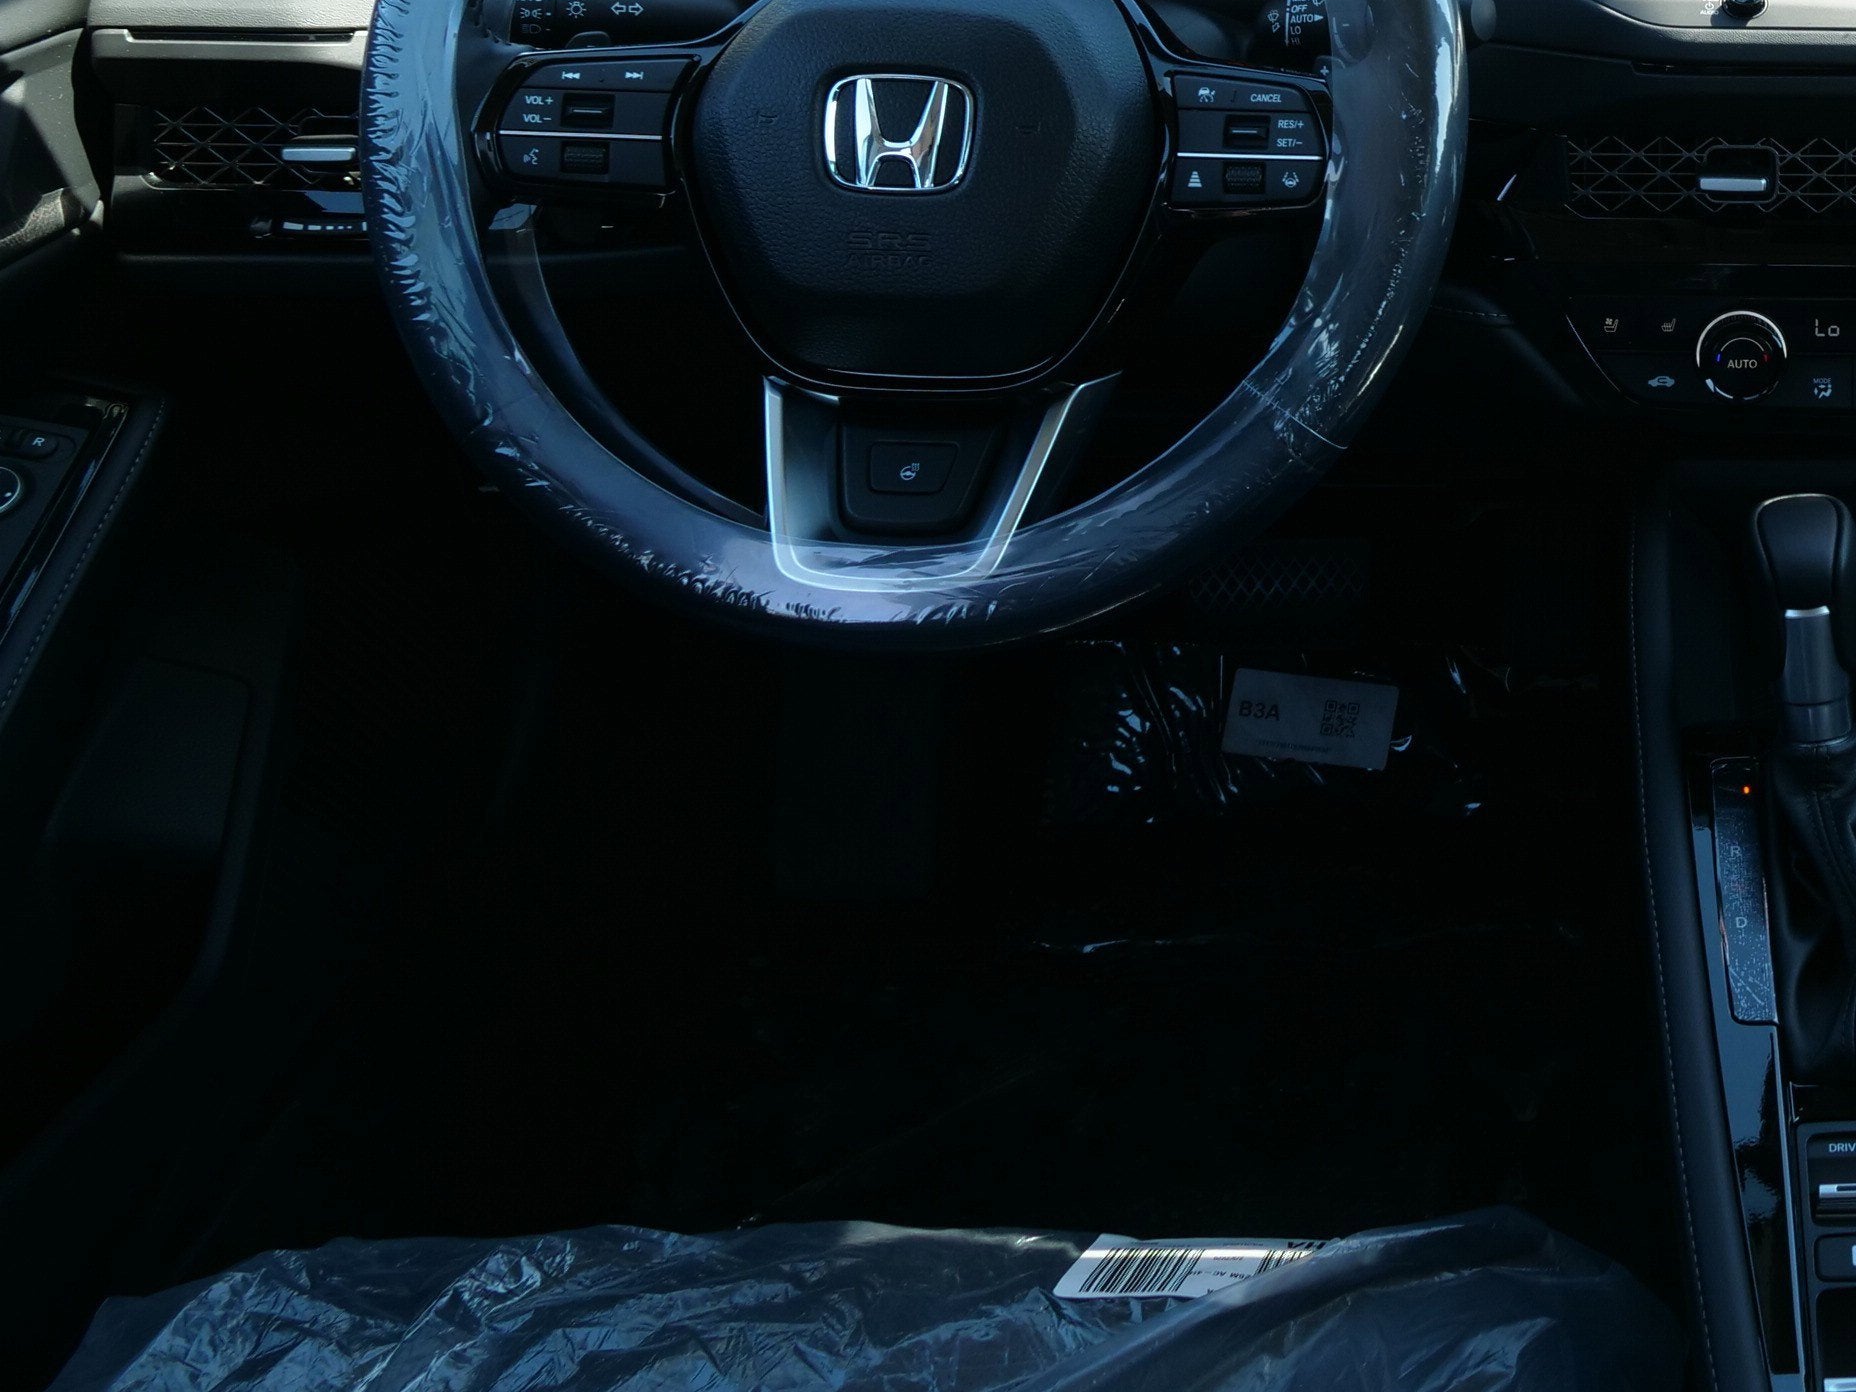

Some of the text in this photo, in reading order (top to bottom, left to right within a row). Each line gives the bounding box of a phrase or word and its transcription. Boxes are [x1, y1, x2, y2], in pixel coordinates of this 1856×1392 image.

[1291, 5, 1308, 13] OFF
[1290, 14, 1313, 23] AUTO
[1291, 26, 1301, 34] LO
[1251, 94, 1282, 103] CANCEL
[1278, 120, 1304, 129] RES/+
[1277, 139, 1302, 147] SET/-
[1728, 360, 1758, 369] AUTO
[32, 437, 45, 446] R
[1239, 701, 1280, 721] B3A
[1735, 917, 1747, 928] D
